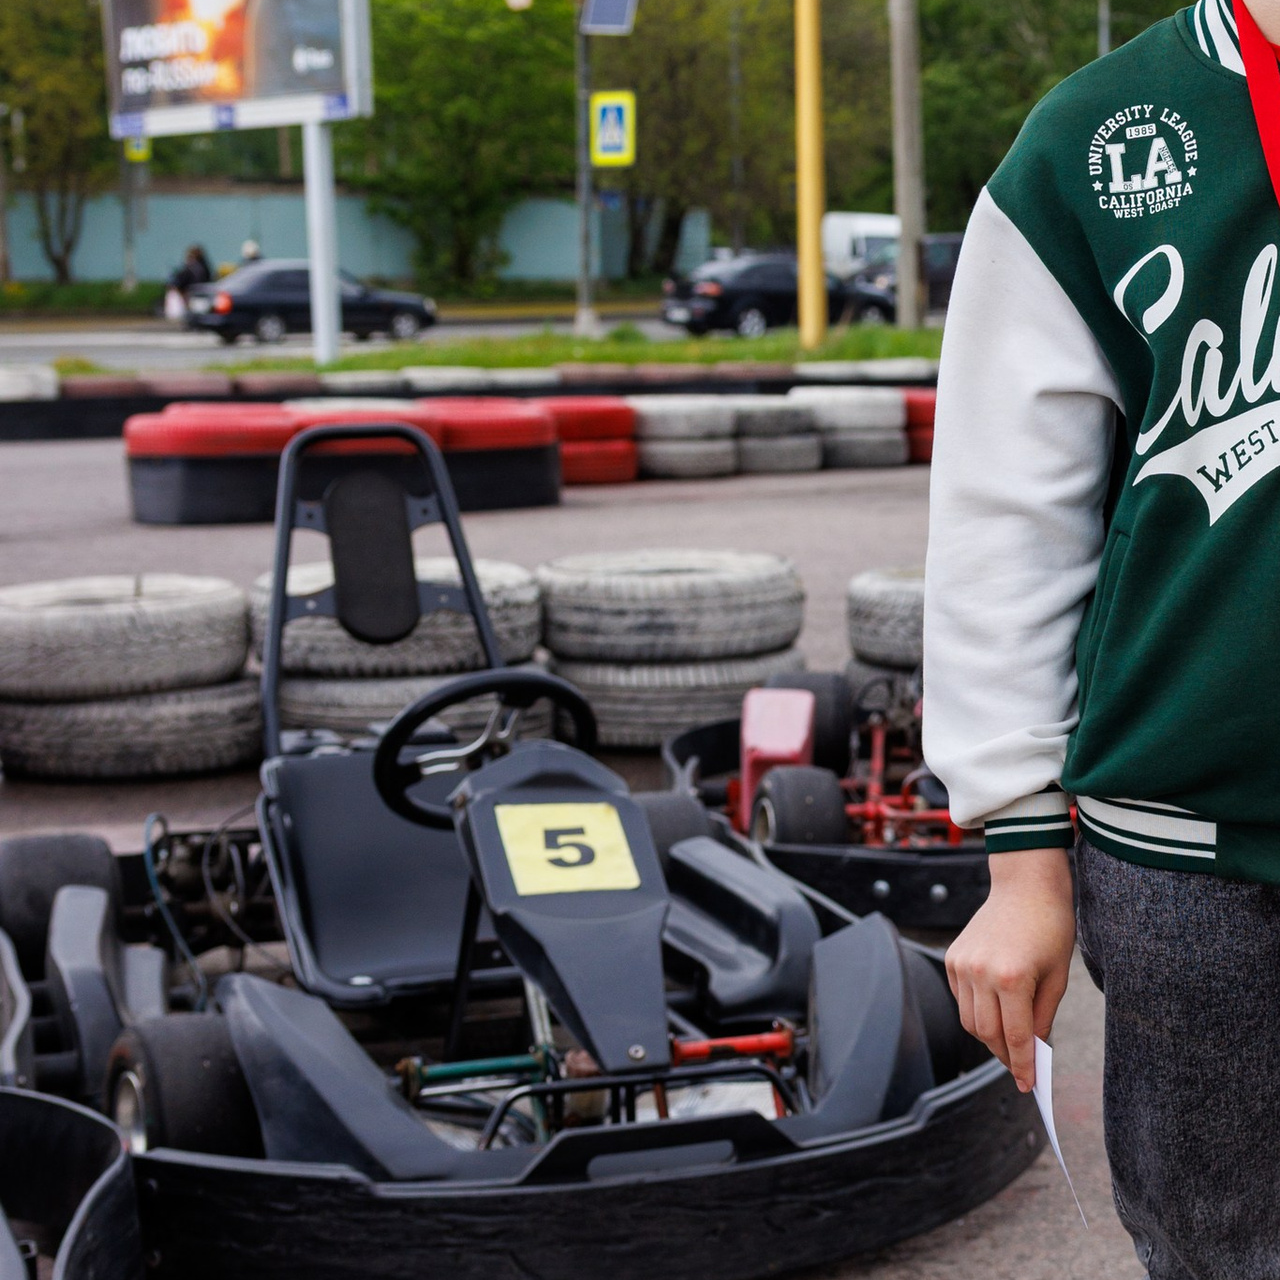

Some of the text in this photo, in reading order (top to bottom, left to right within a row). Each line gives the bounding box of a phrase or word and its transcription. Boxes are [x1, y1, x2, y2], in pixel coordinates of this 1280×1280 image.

[1088, 104, 1198, 176] UNIVERSITY LEAGUE
[1128, 124, 1154, 138] 1985
[1105, 136, 1182, 194] LA
[1099, 182, 1193, 209] CALIFORNIA
[1113, 198, 1181, 219] WEST COAST
[1196, 420, 1279, 493] WEST
[543, 826, 596, 869] 5
